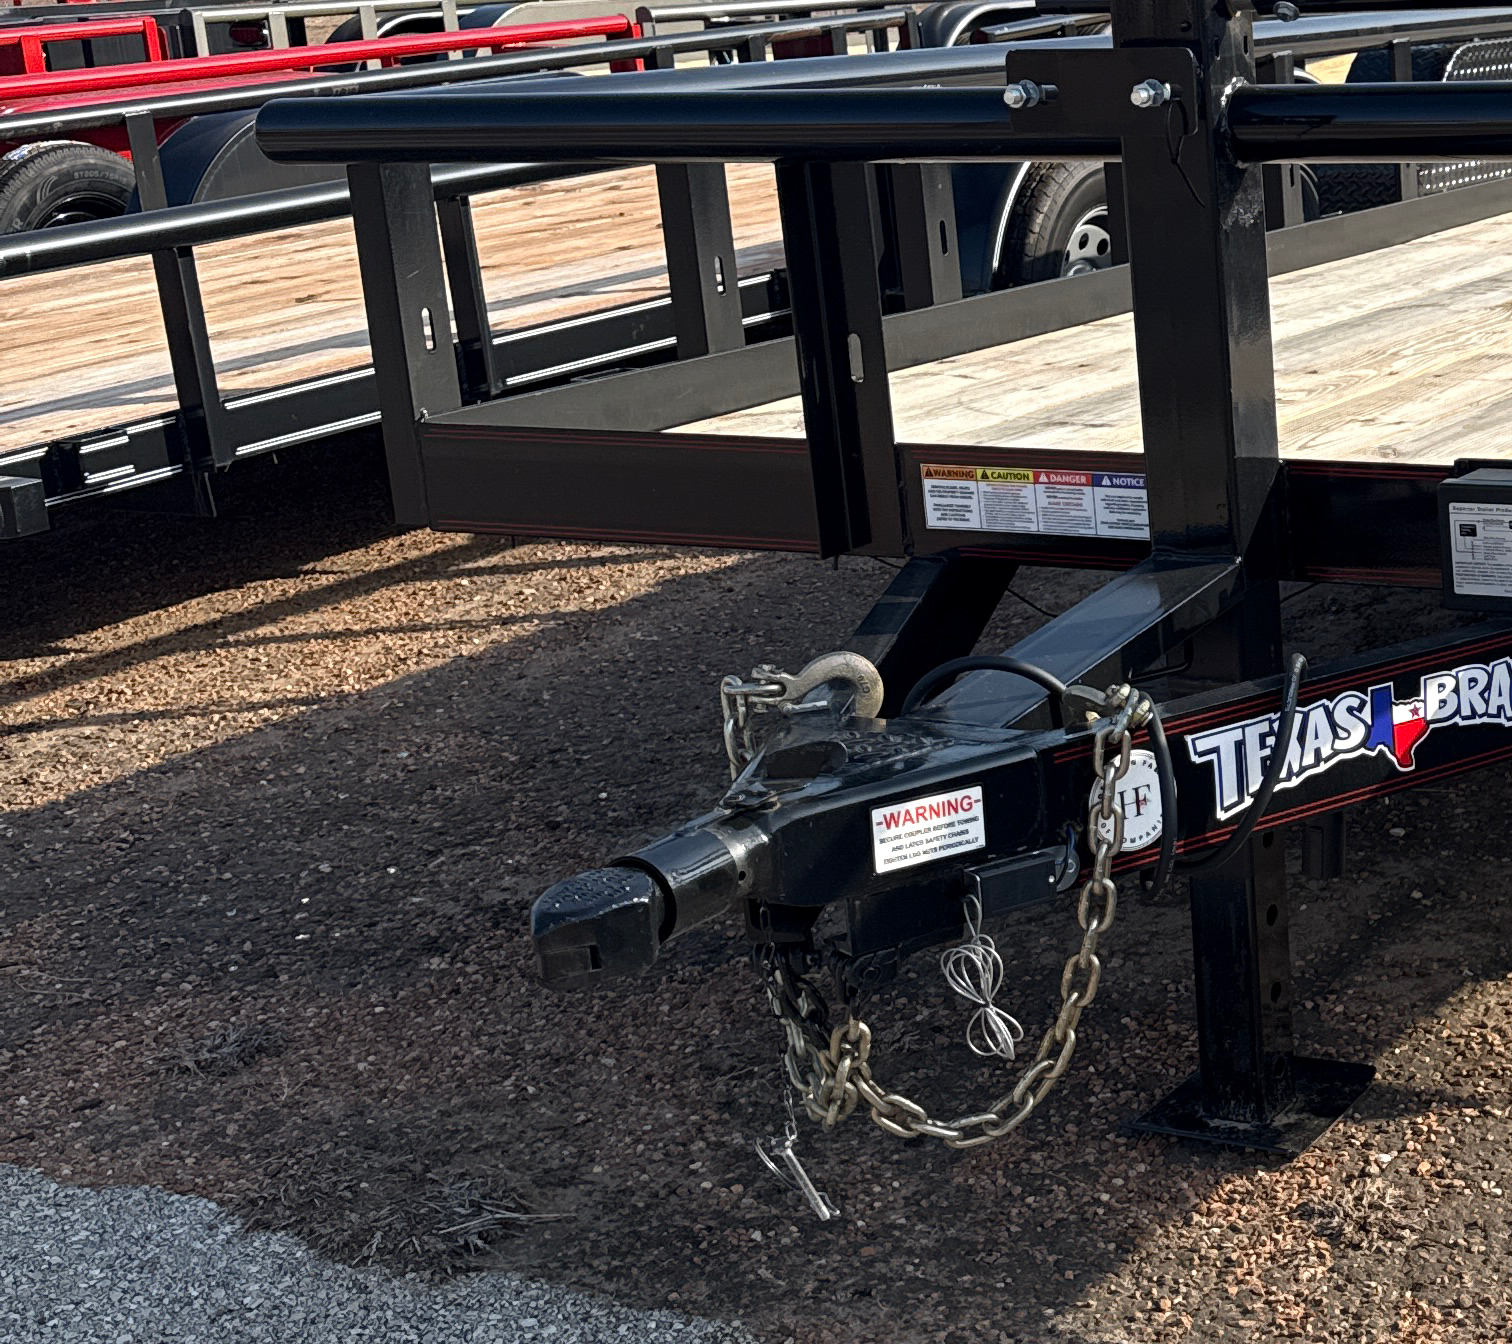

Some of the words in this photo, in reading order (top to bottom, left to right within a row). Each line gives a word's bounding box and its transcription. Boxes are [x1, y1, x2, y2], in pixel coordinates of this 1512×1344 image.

[933, 468, 974, 478] WARNING
[991, 471, 1029, 481] CAUTION
[1049, 474, 1087, 484] DANGER
[1113, 477, 1144, 486] NOTICE
[1189, 691, 1371, 818] TEXAS
[933, 821, 956, 831] BEFORE
[925, 834, 947, 844] SAFETY
